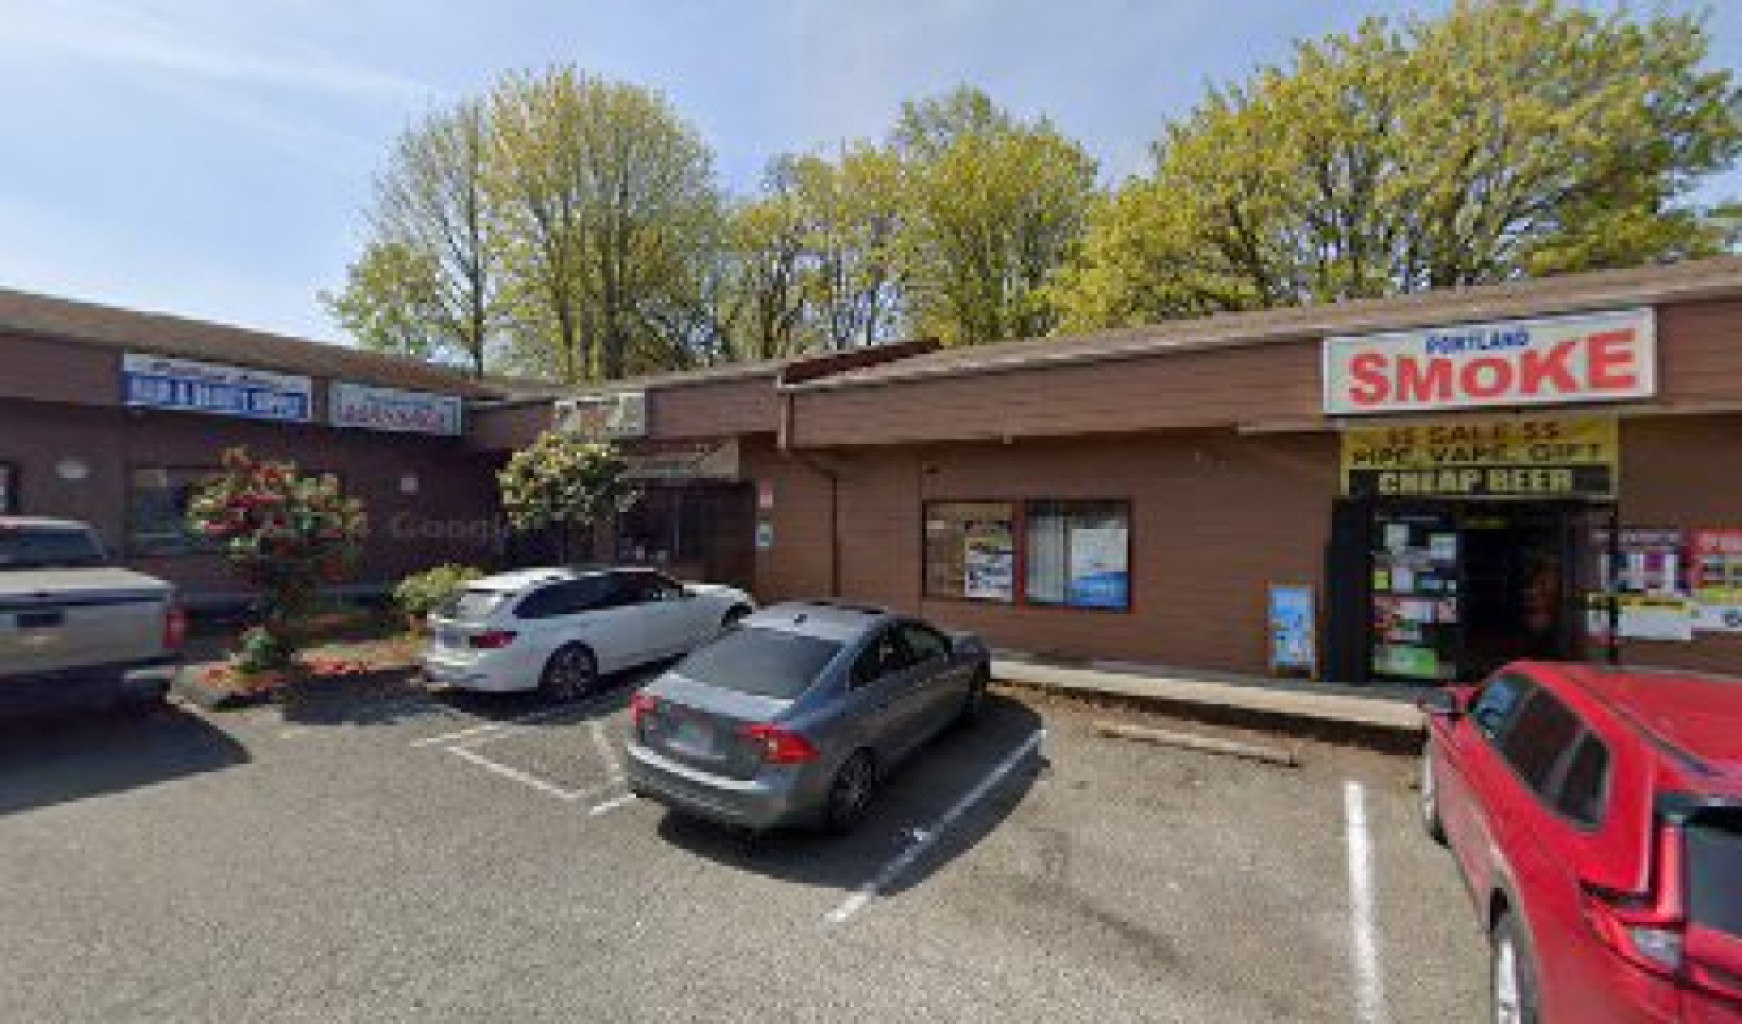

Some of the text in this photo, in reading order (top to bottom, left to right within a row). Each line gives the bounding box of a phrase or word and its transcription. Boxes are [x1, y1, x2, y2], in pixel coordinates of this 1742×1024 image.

[1426, 328, 1529, 354] PORTLAND
[1349, 329, 1637, 408] SMOKE
[1378, 469, 1573, 494] CHEAP BEER
